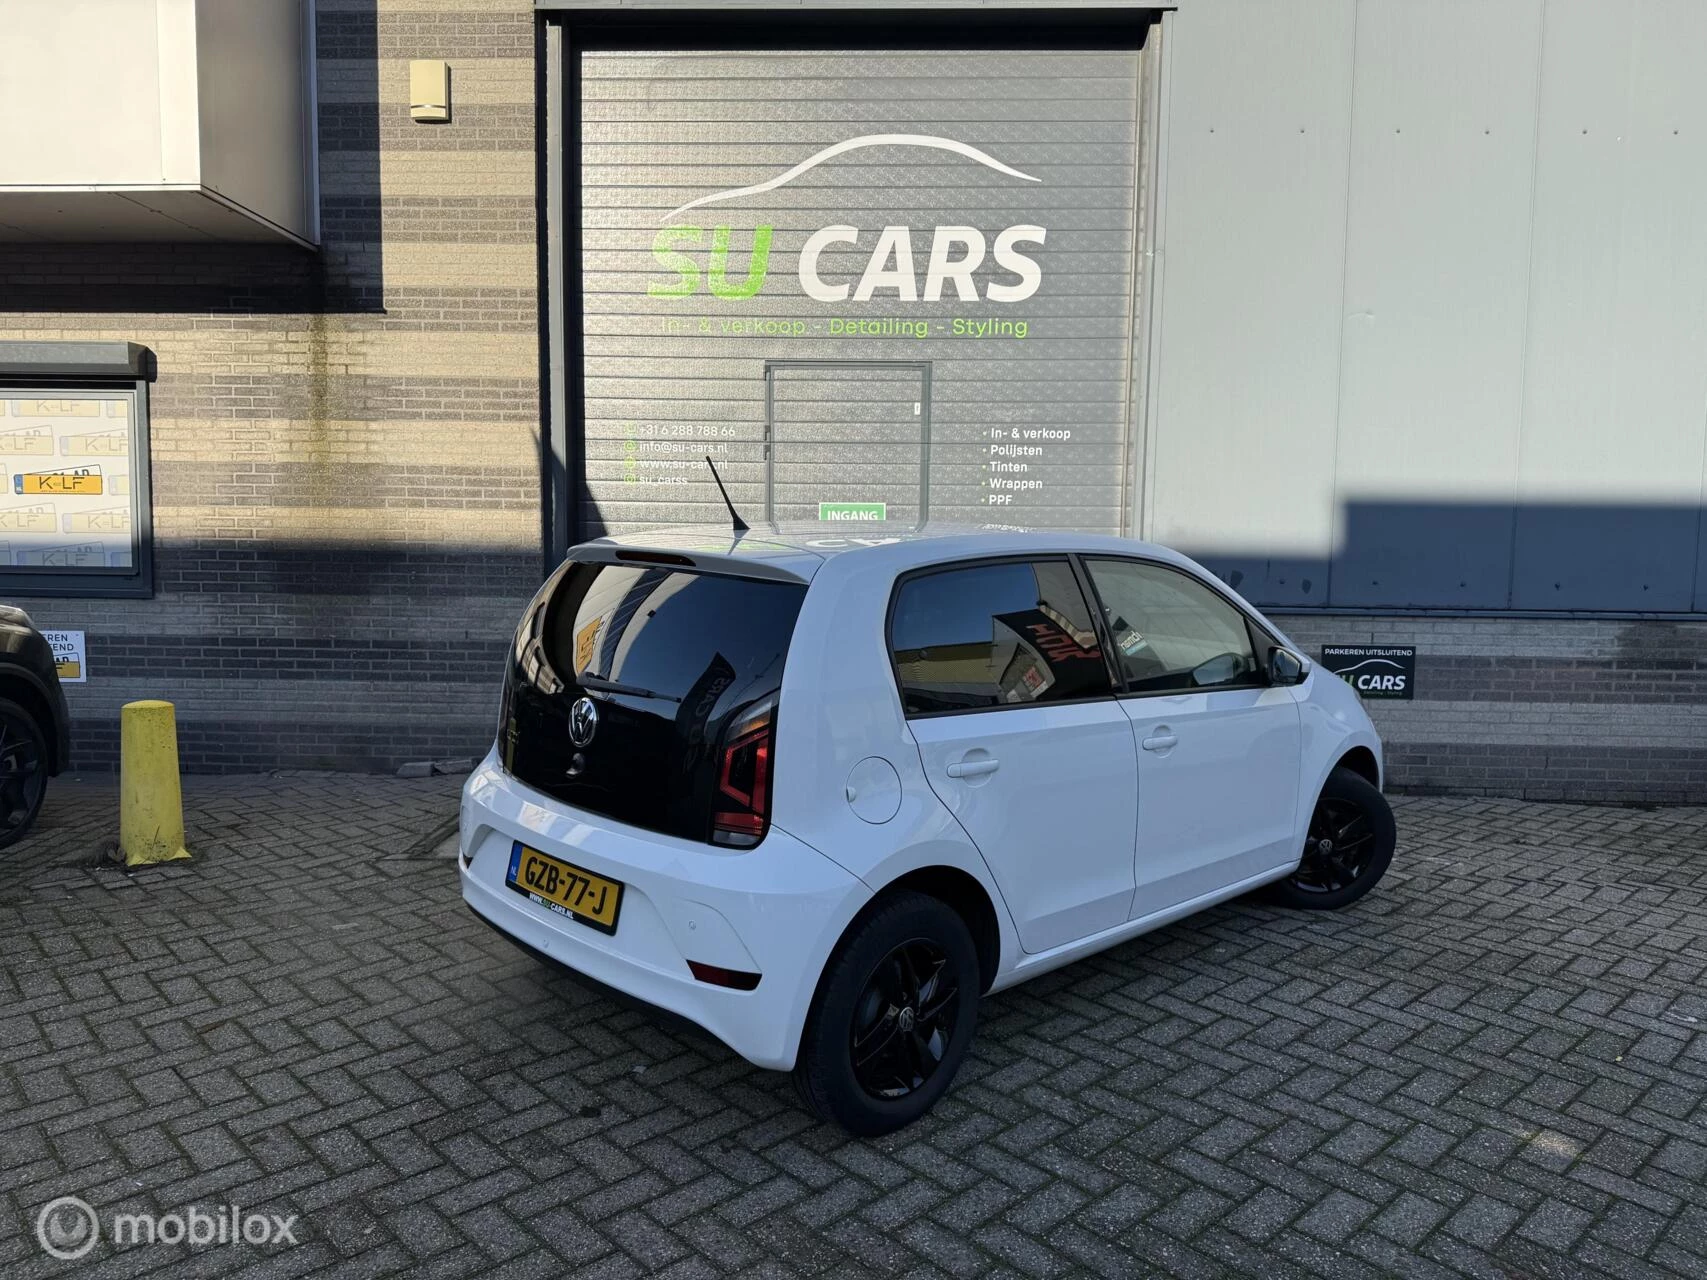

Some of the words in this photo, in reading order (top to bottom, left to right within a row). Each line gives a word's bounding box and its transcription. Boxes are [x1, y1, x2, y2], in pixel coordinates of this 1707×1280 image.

[647, 224, 773, 300] SU
[798, 224, 1047, 303] CARS
[720, 318, 805, 337] verkoop
[829, 318, 929, 338] Detailing
[952, 318, 1028, 339] Styling
[672, 425, 693, 436] 288
[697, 425, 718, 437] 788
[721, 427, 736, 437] 66
[991, 427, 1008, 439] In-
[1011, 427, 1020, 439] &
[1023, 428, 1071, 441] verkoop
[640, 441, 728, 453] info@su-cars.nl
[990, 444, 1043, 458] Polijsten
[640, 460, 728, 470] www.su-car.nl
[989, 461, 1028, 473] Tinten
[989, 478, 1043, 491] Wrappen
[989, 495, 1013, 505] PPF
[827, 510, 879, 521] INGANG
[1324, 648, 1365, 656] PARKEREN
[1357, 674, 1406, 690] CARS
[524, 856, 608, 915] GZB-77-J
